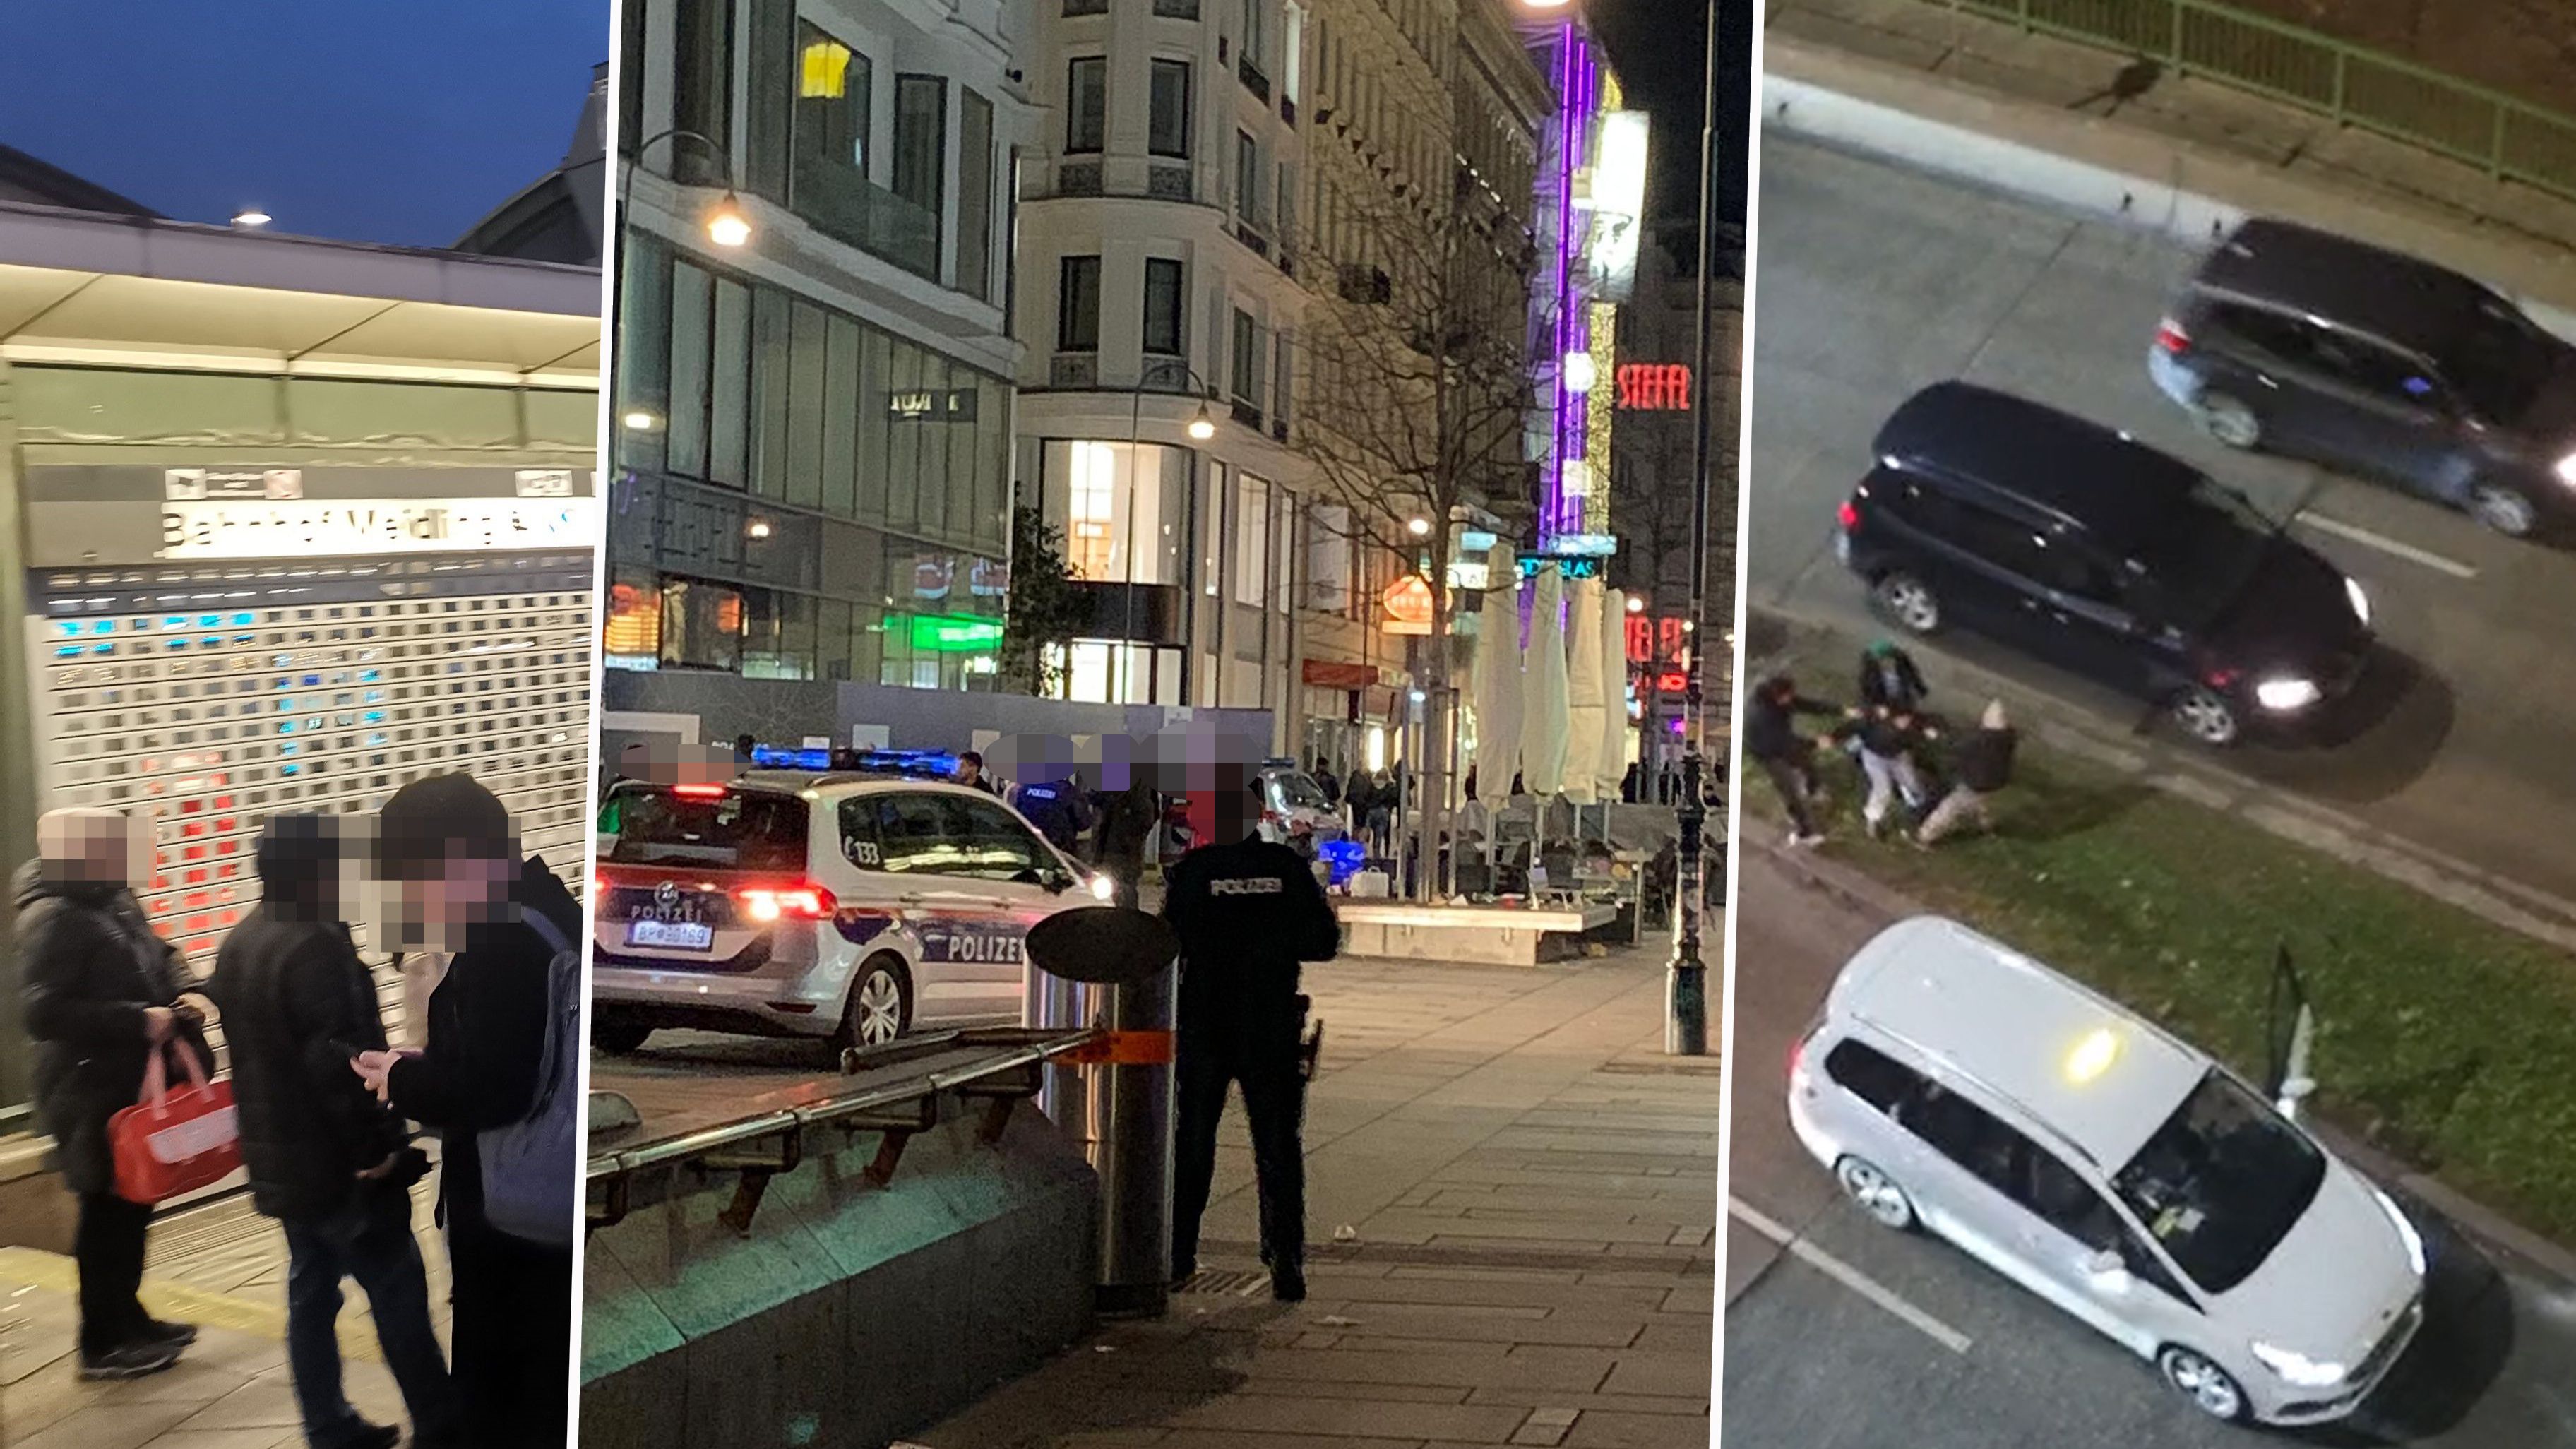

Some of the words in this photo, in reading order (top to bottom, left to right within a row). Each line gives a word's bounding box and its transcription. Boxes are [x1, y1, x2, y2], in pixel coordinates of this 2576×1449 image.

[1617, 364, 1691, 410] STEFFL
[854, 841, 879, 864] 133
[631, 905, 703, 924] POLIZEI
